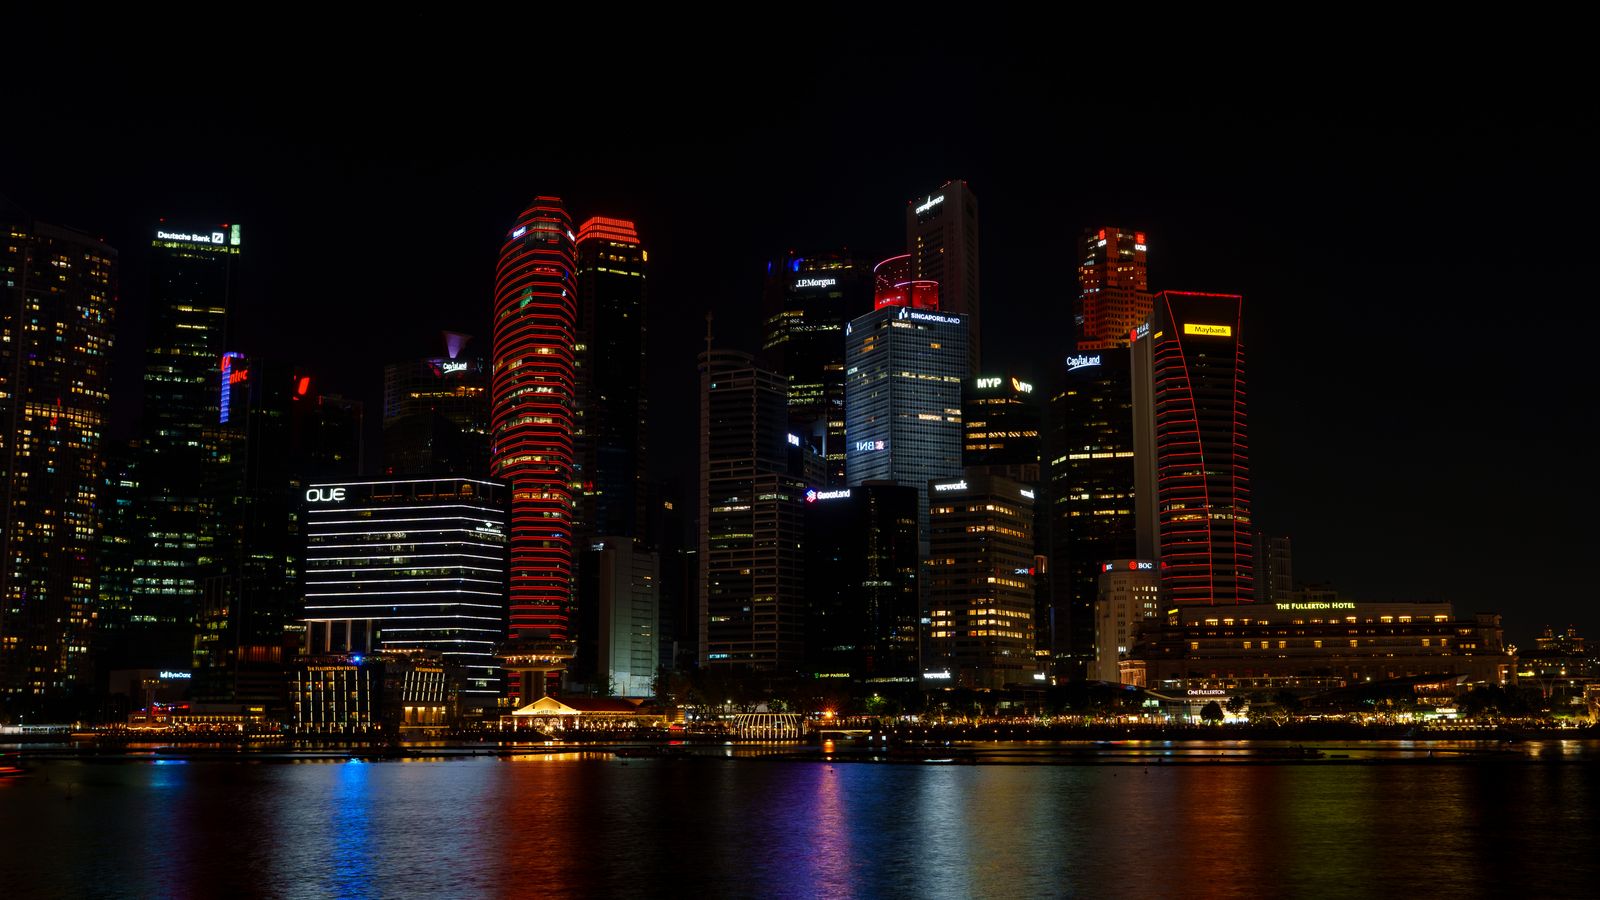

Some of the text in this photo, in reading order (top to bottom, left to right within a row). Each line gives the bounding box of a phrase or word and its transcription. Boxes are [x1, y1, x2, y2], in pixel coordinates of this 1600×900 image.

[158, 231, 210, 242] Deutsche Bank
[796, 278, 836, 288] J.P.Morgan
[910, 312, 960, 324] SINGAPORELAND
[1194, 326, 1227, 335] Maybank
[1066, 354, 1100, 367] CapitaLand
[977, 378, 1002, 388] MYP
[1020, 381, 1032, 394] MYP
[935, 480, 967, 491] wework
[306, 488, 346, 502] OUE
[817, 489, 850, 500] GuocoLand
